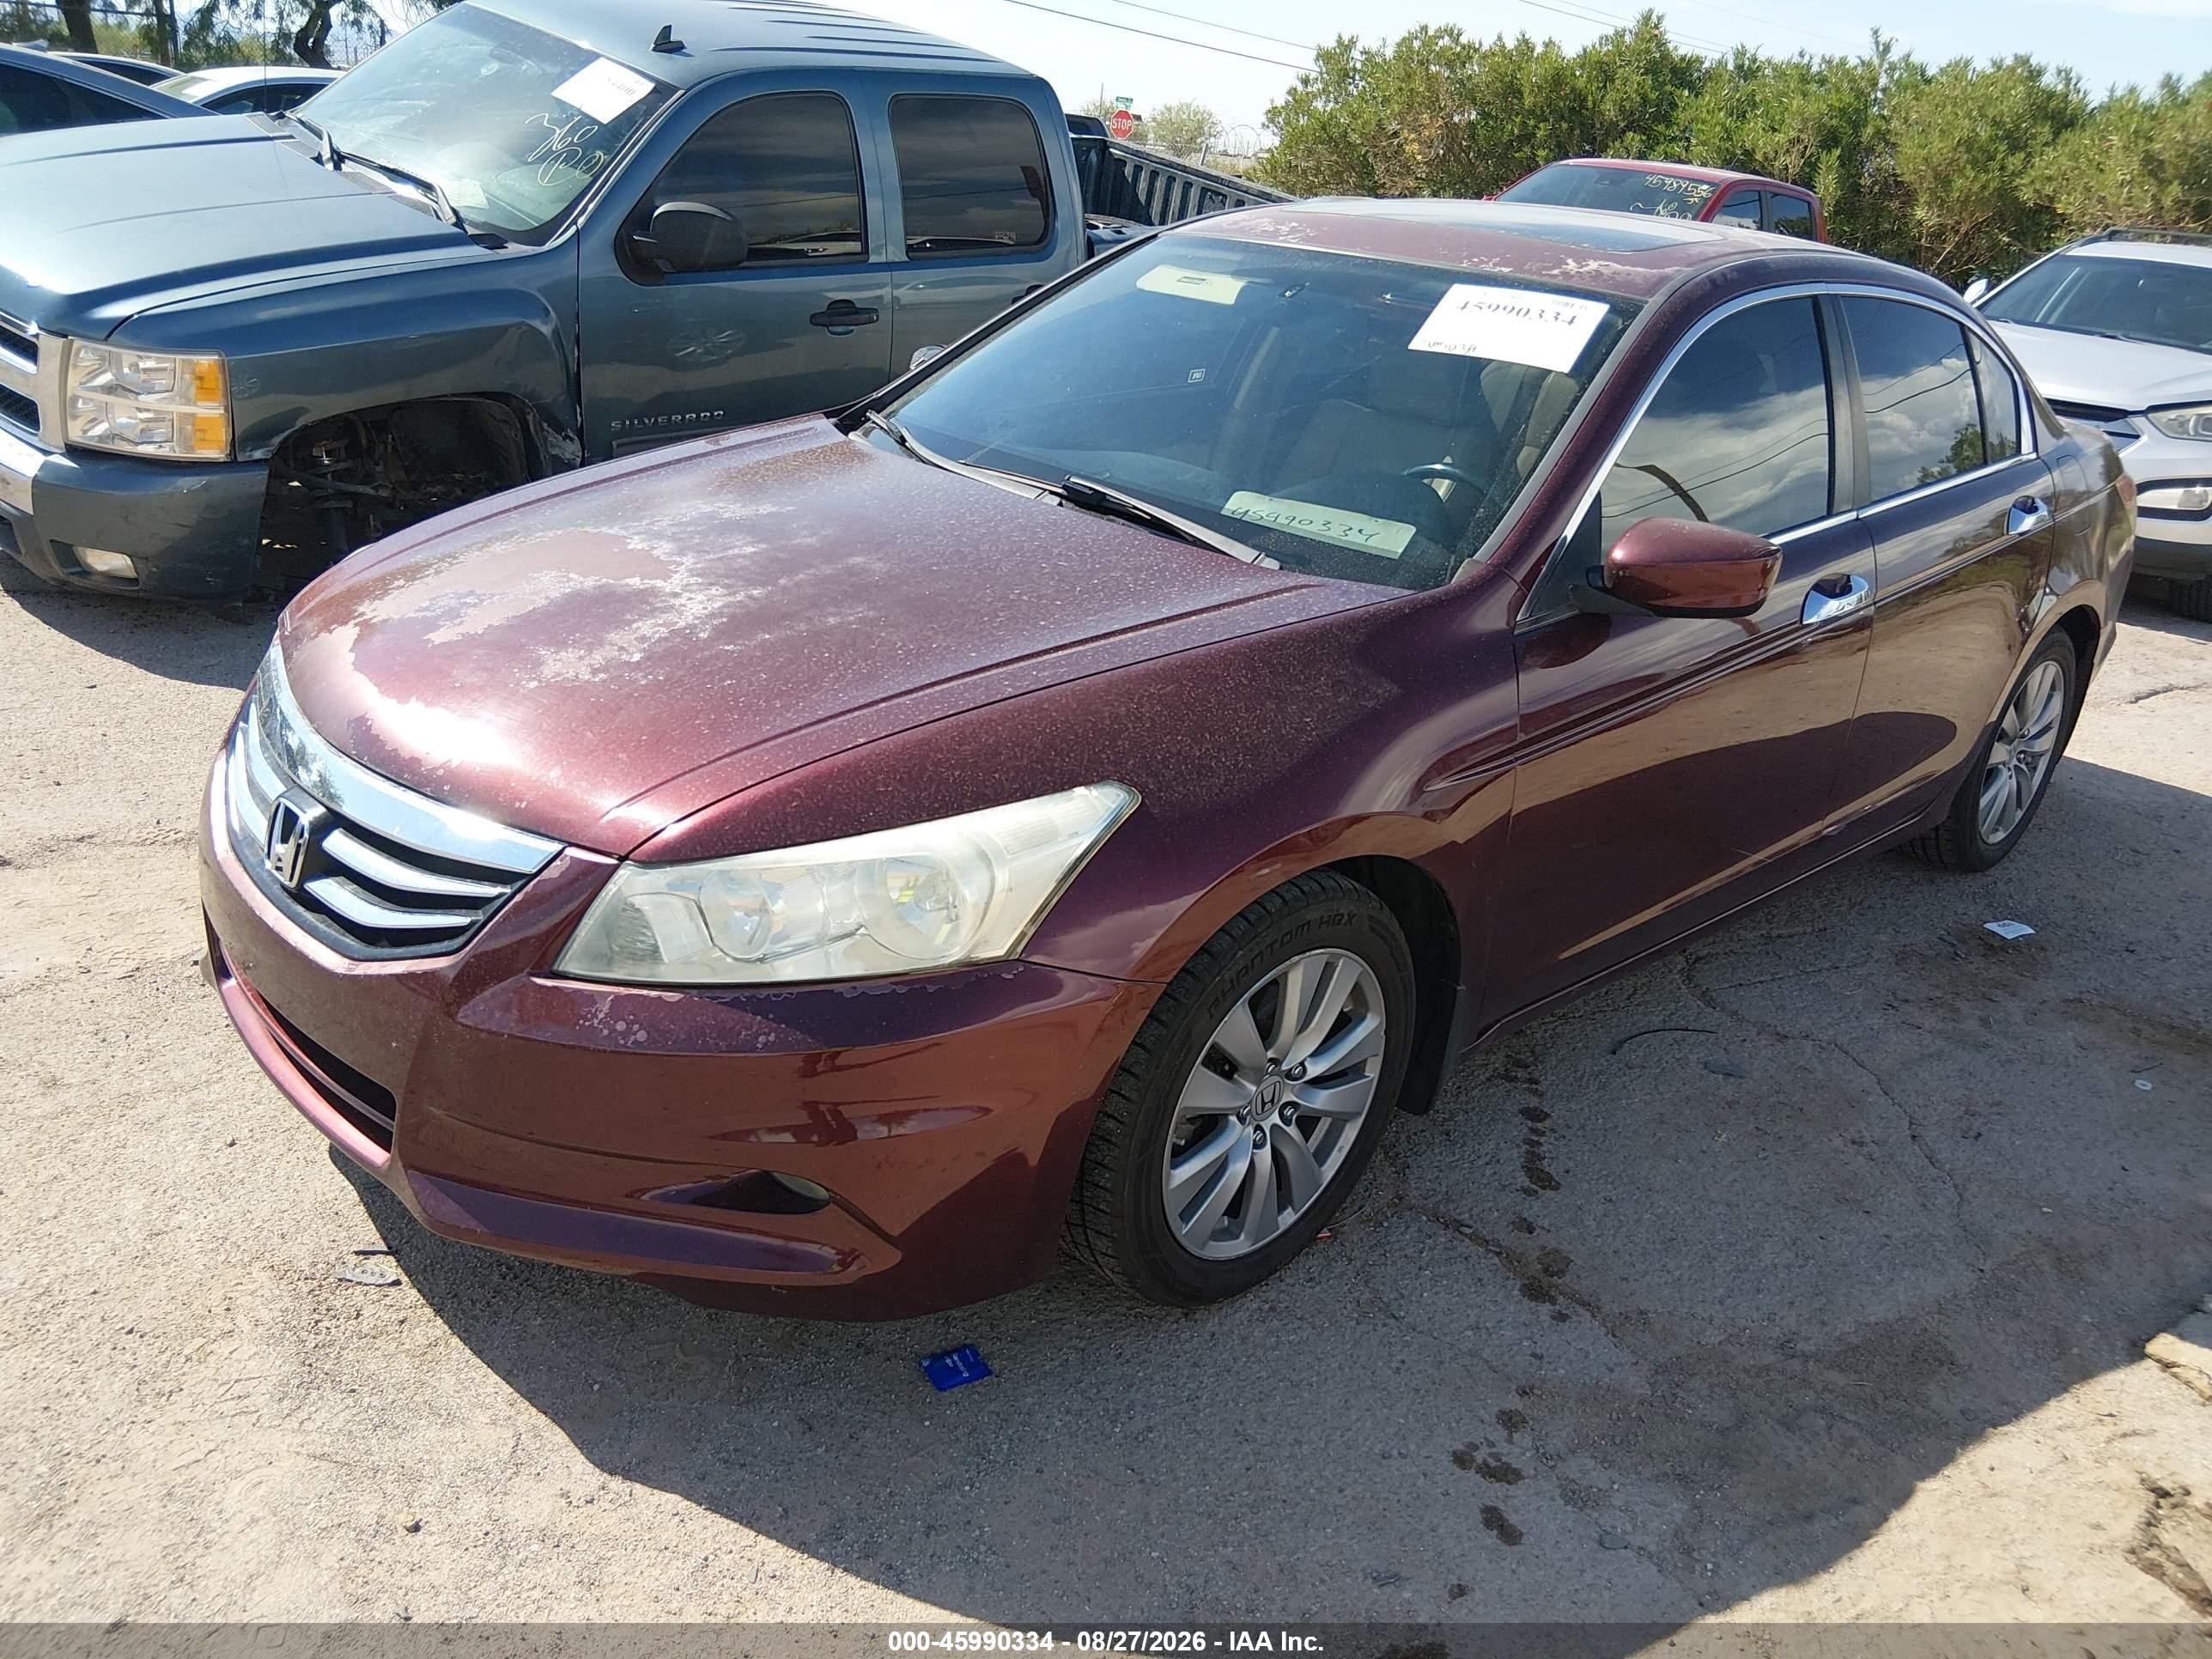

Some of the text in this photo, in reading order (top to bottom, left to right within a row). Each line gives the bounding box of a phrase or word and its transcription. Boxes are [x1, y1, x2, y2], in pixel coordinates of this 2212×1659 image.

[1112, 118, 1133, 131] STOP
[1644, 174, 1716, 198] 45989556
[611, 410, 724, 431] SILVERADO
[1231, 507, 1380, 543] 45990334
